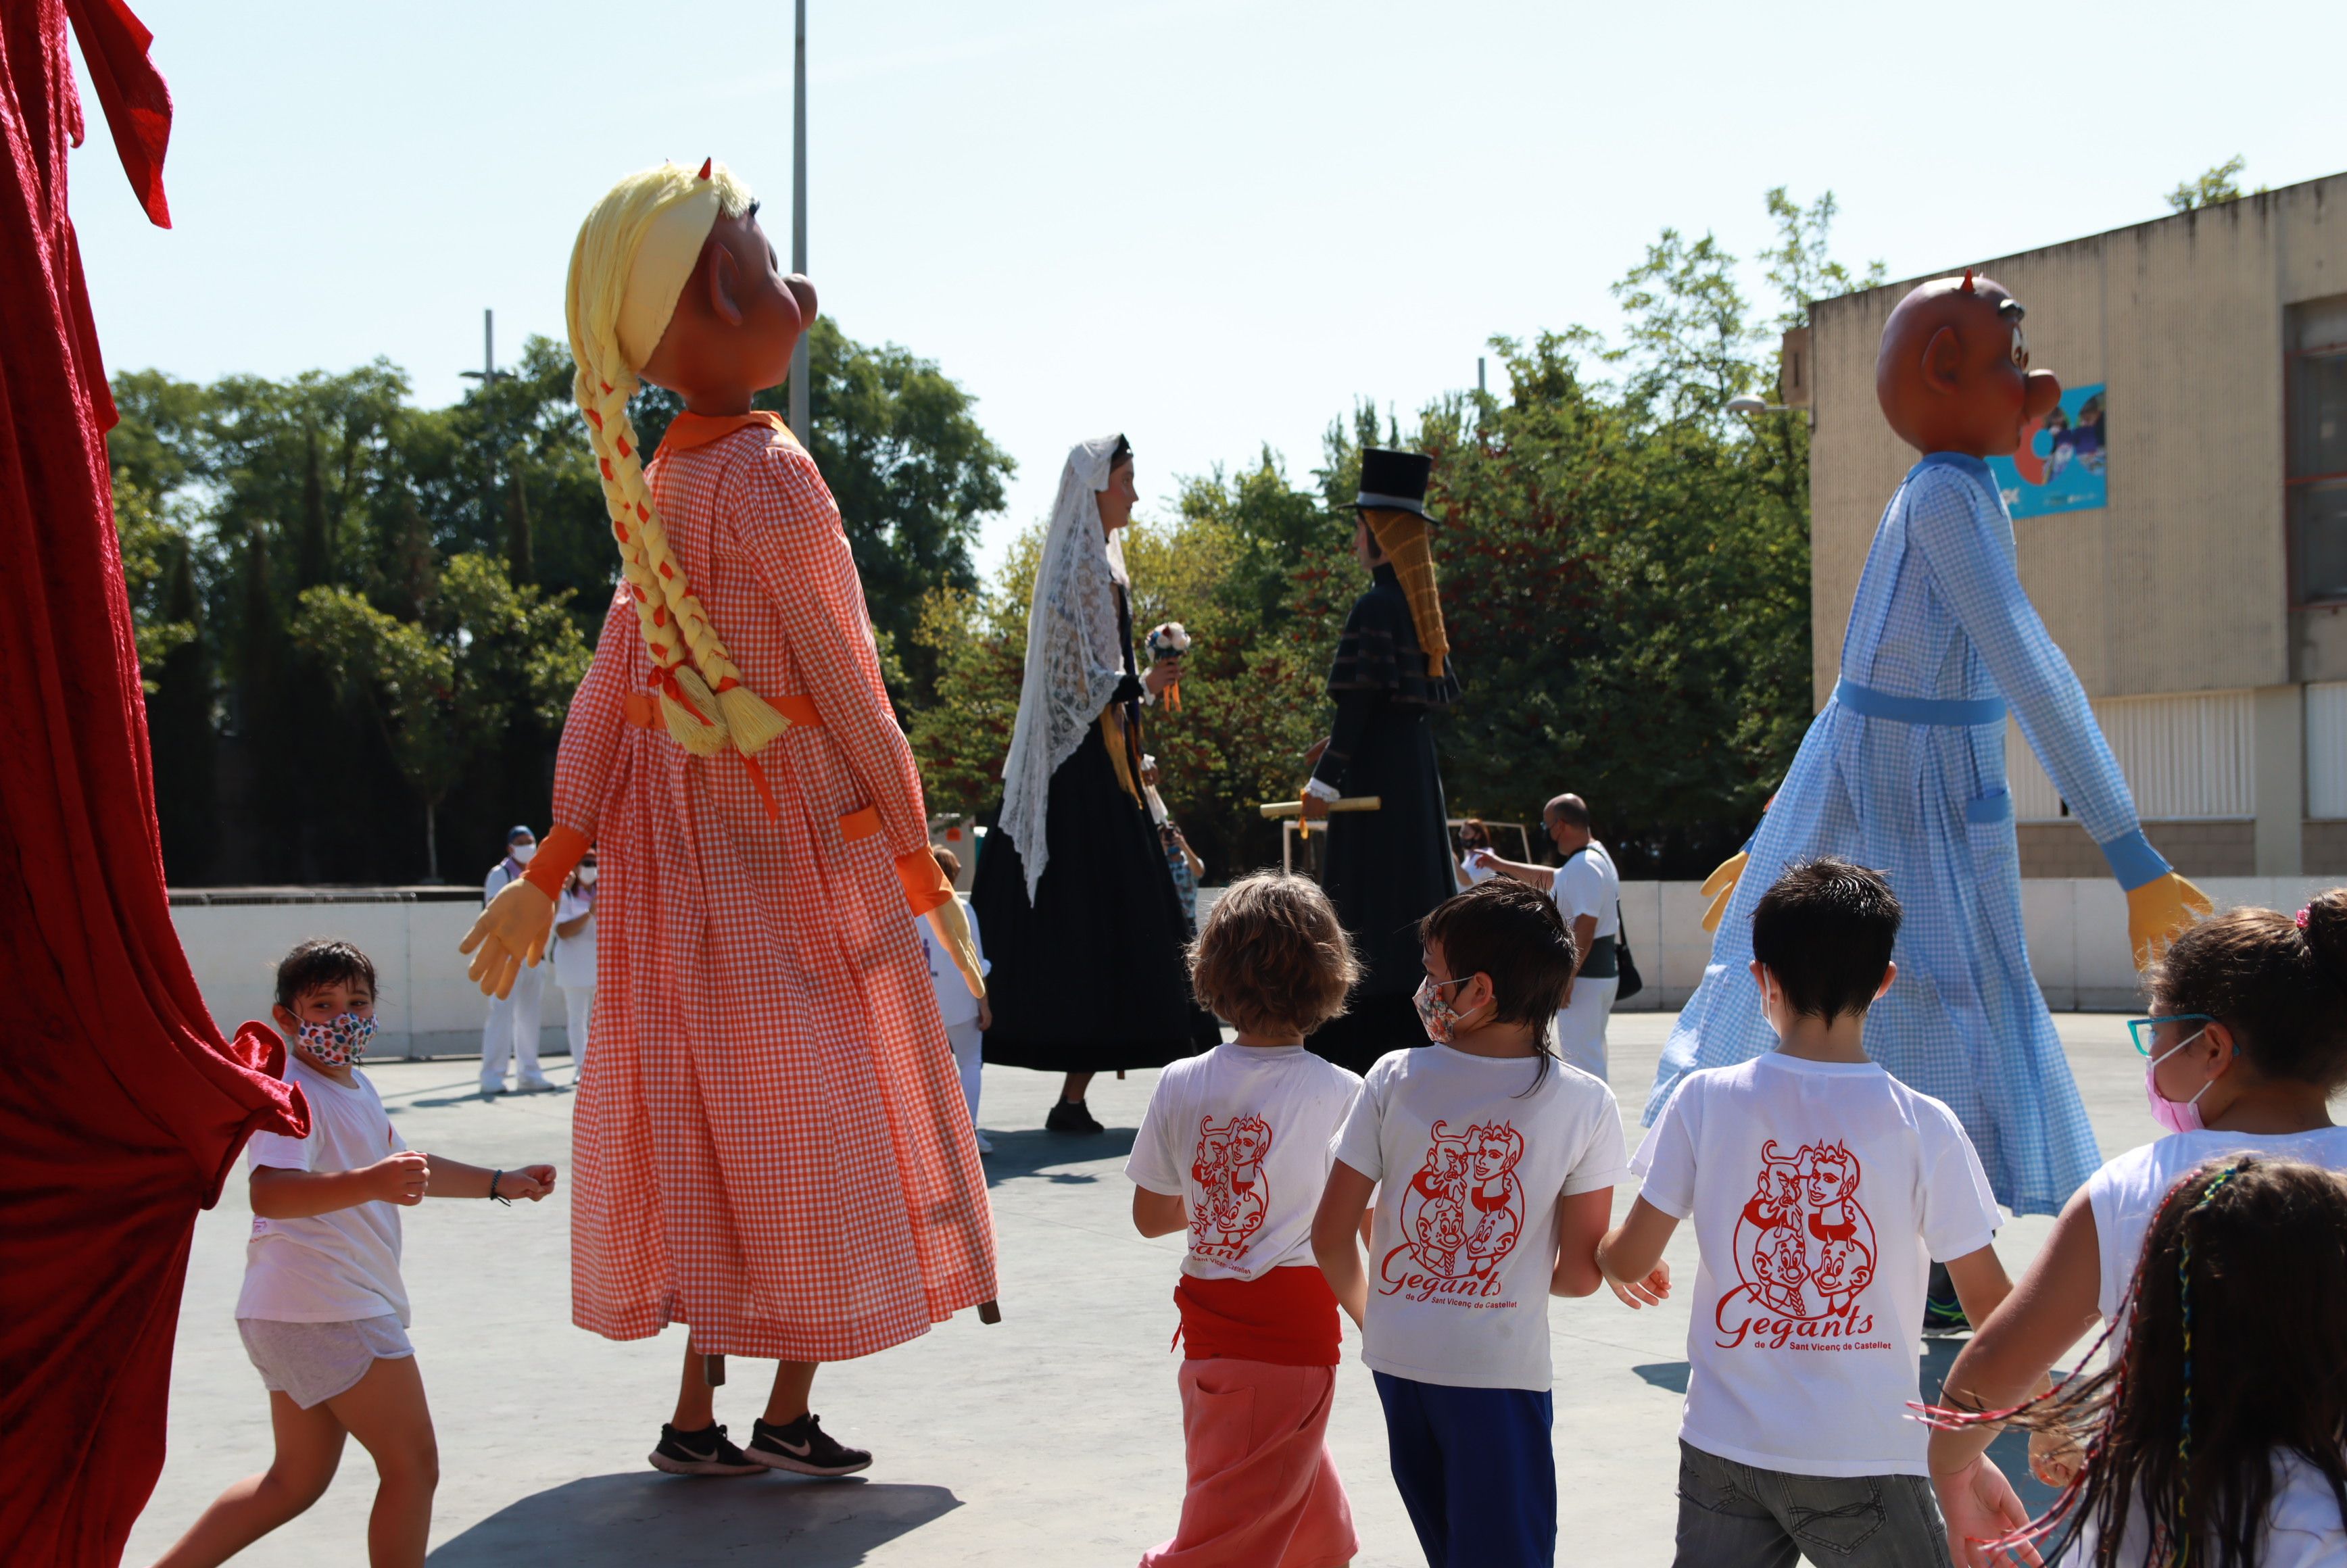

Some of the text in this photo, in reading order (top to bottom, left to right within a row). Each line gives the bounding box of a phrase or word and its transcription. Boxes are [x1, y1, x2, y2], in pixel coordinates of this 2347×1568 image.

[1405, 1293, 1415, 1301] de
[1432, 1296, 1446, 1304] Sant
[1447, 1298, 1472, 1308] Vicenç
[1716, 1283, 1873, 1349] Gegants
[1789, 1342, 1809, 1351] Sant
[1811, 1343, 1841, 1352] Vicenç
[1843, 1342, 1852, 1350] de
[1854, 1341, 1891, 1350] Castellet
